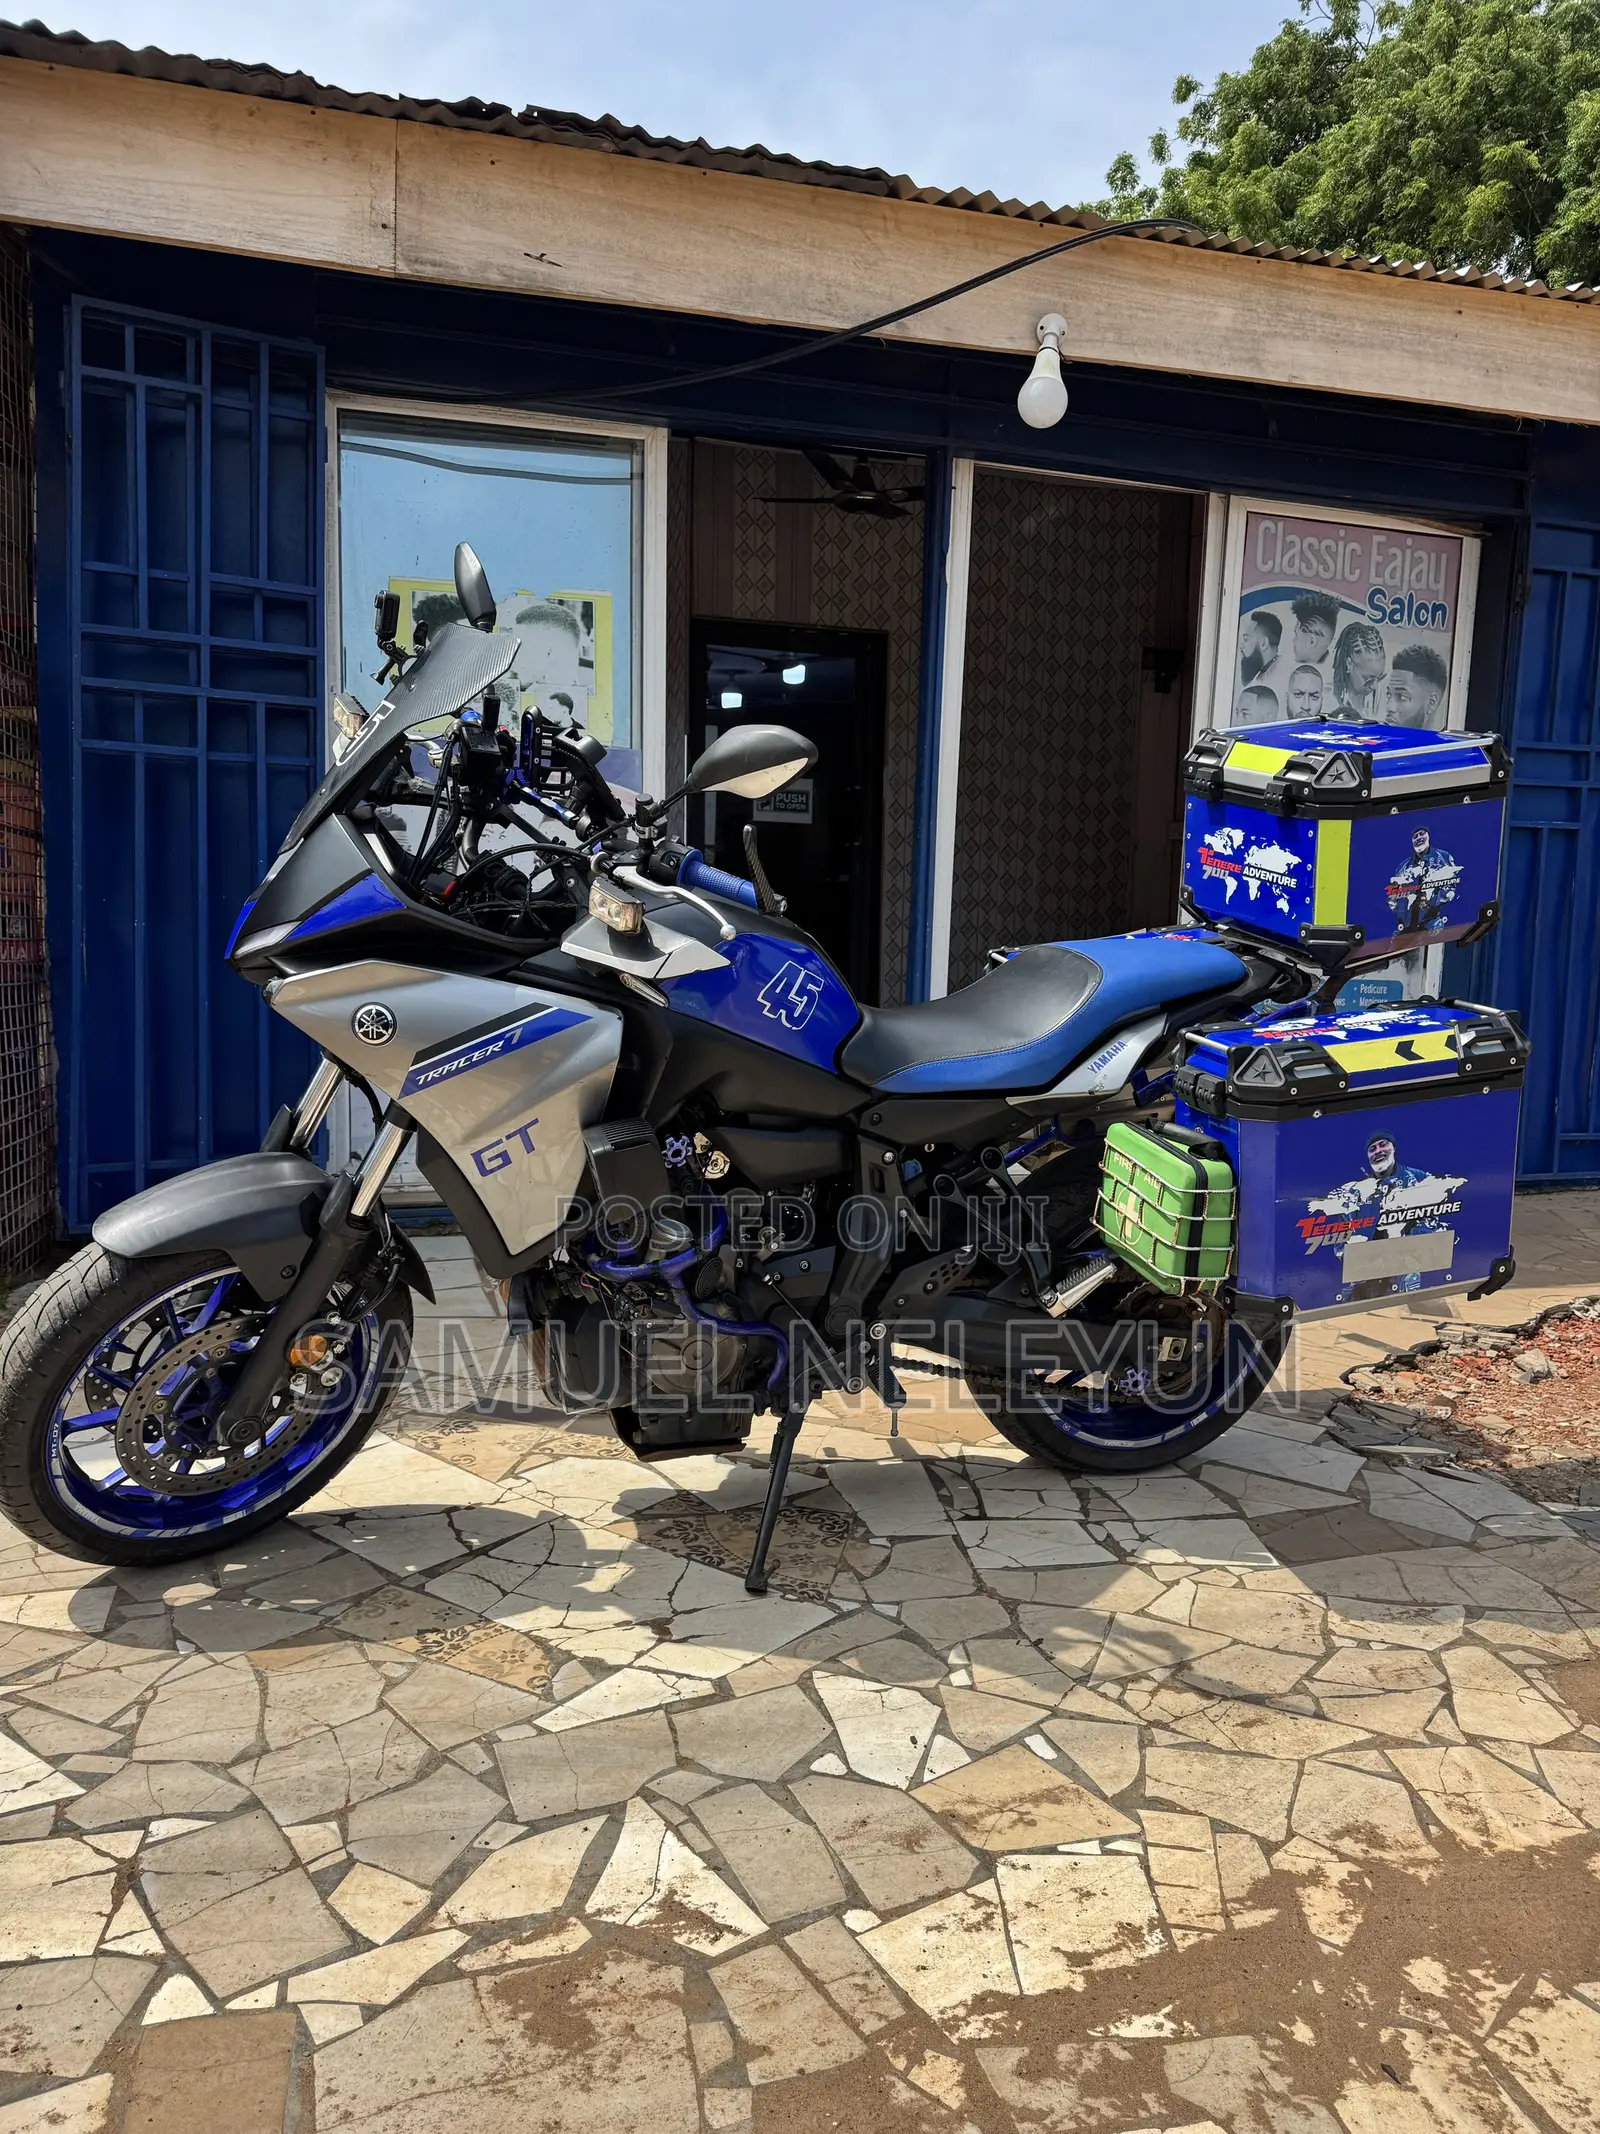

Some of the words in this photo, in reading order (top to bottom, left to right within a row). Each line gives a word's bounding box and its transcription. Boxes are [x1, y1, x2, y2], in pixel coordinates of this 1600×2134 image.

[1256, 519, 1363, 583] Classic
[1369, 533, 1448, 600] Eajay
[1366, 586, 1449, 630] Salon
[775, 793, 807, 804] PUSH
[1243, 866, 1297, 889] ADVENTURE
[1422, 878, 1461, 890] ADVENTURE
[757, 960, 825, 1031] 45
[1360, 984, 1388, 994] Pedicure
[416, 1040, 505, 1086] TRACER
[504, 1027, 524, 1045] 7
[1086, 1040, 1128, 1074] YAMAHA
[470, 1117, 540, 1178] GT
[1378, 1201, 1462, 1226] ADVENTURE
[51, 1423, 60, 1458] MT-07
